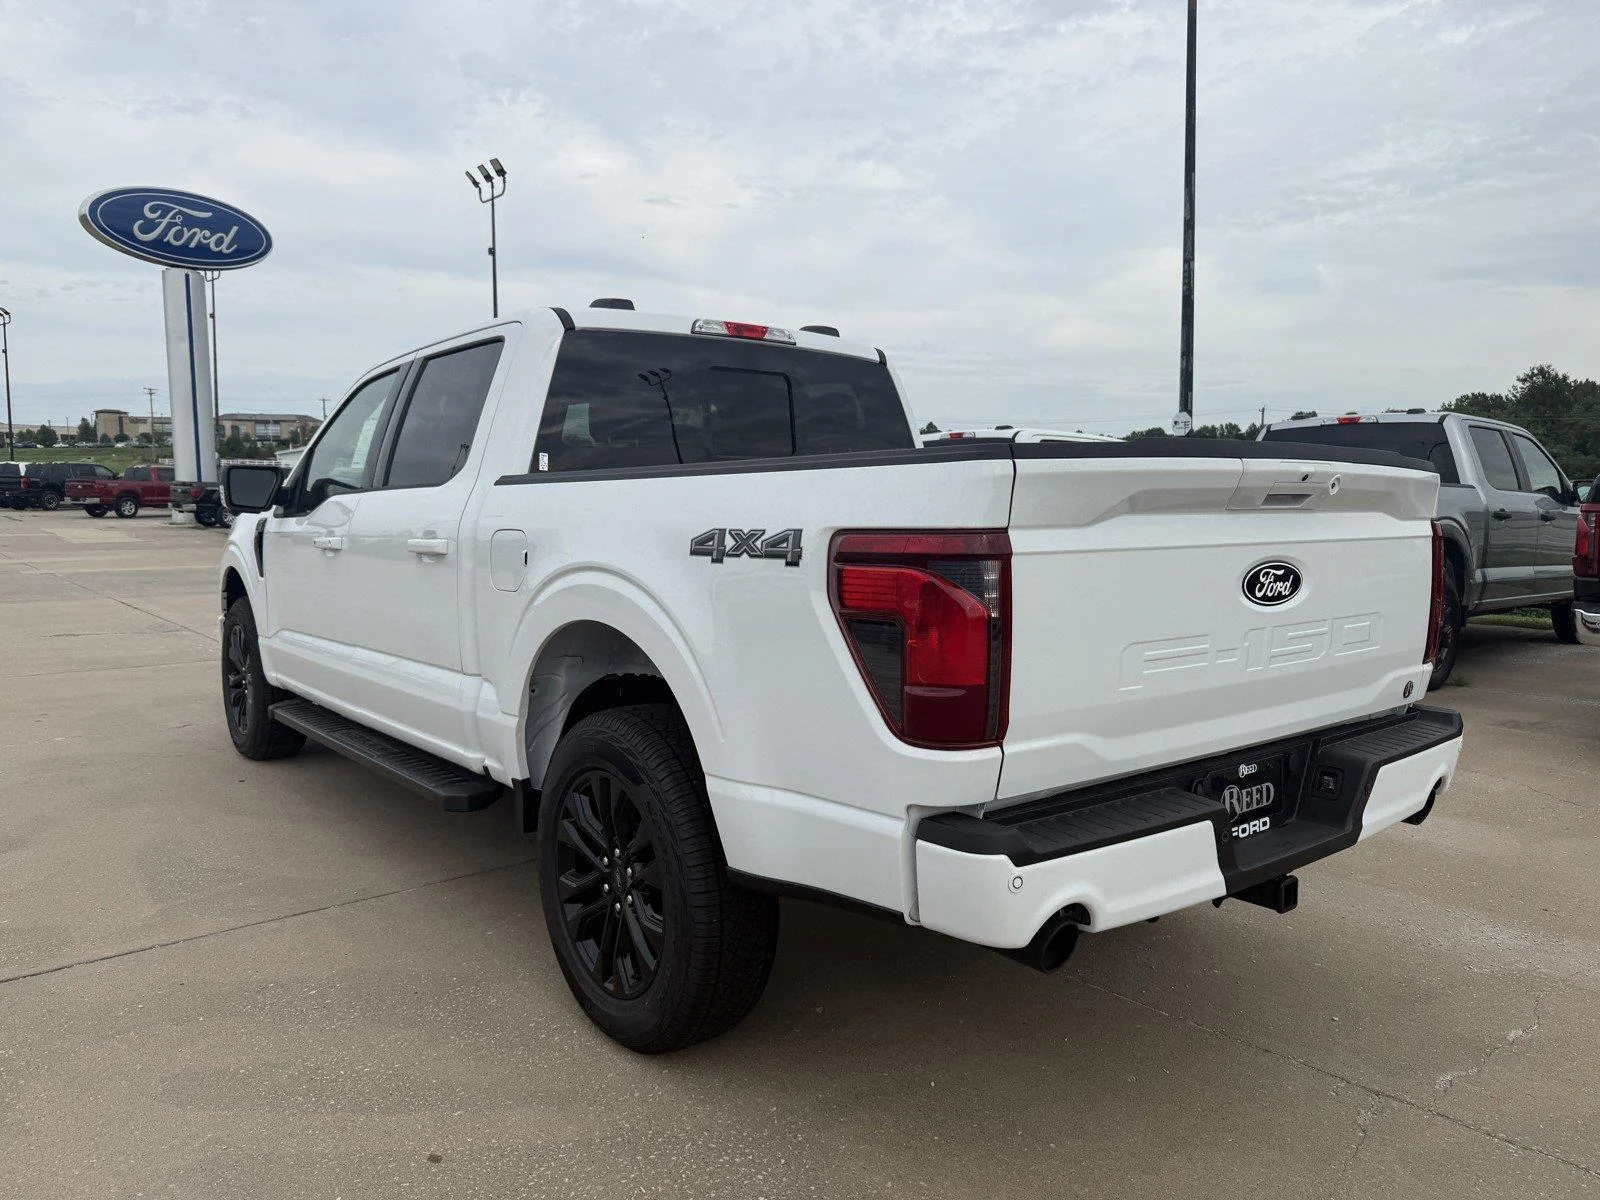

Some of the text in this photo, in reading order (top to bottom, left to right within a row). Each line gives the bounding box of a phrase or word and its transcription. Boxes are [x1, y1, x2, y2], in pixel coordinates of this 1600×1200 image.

[133, 201, 238, 254] Ford
[1255, 568, 1294, 598] Ford
[1118, 612, 1382, 691] F-150
[1222, 782, 1275, 817] REED
